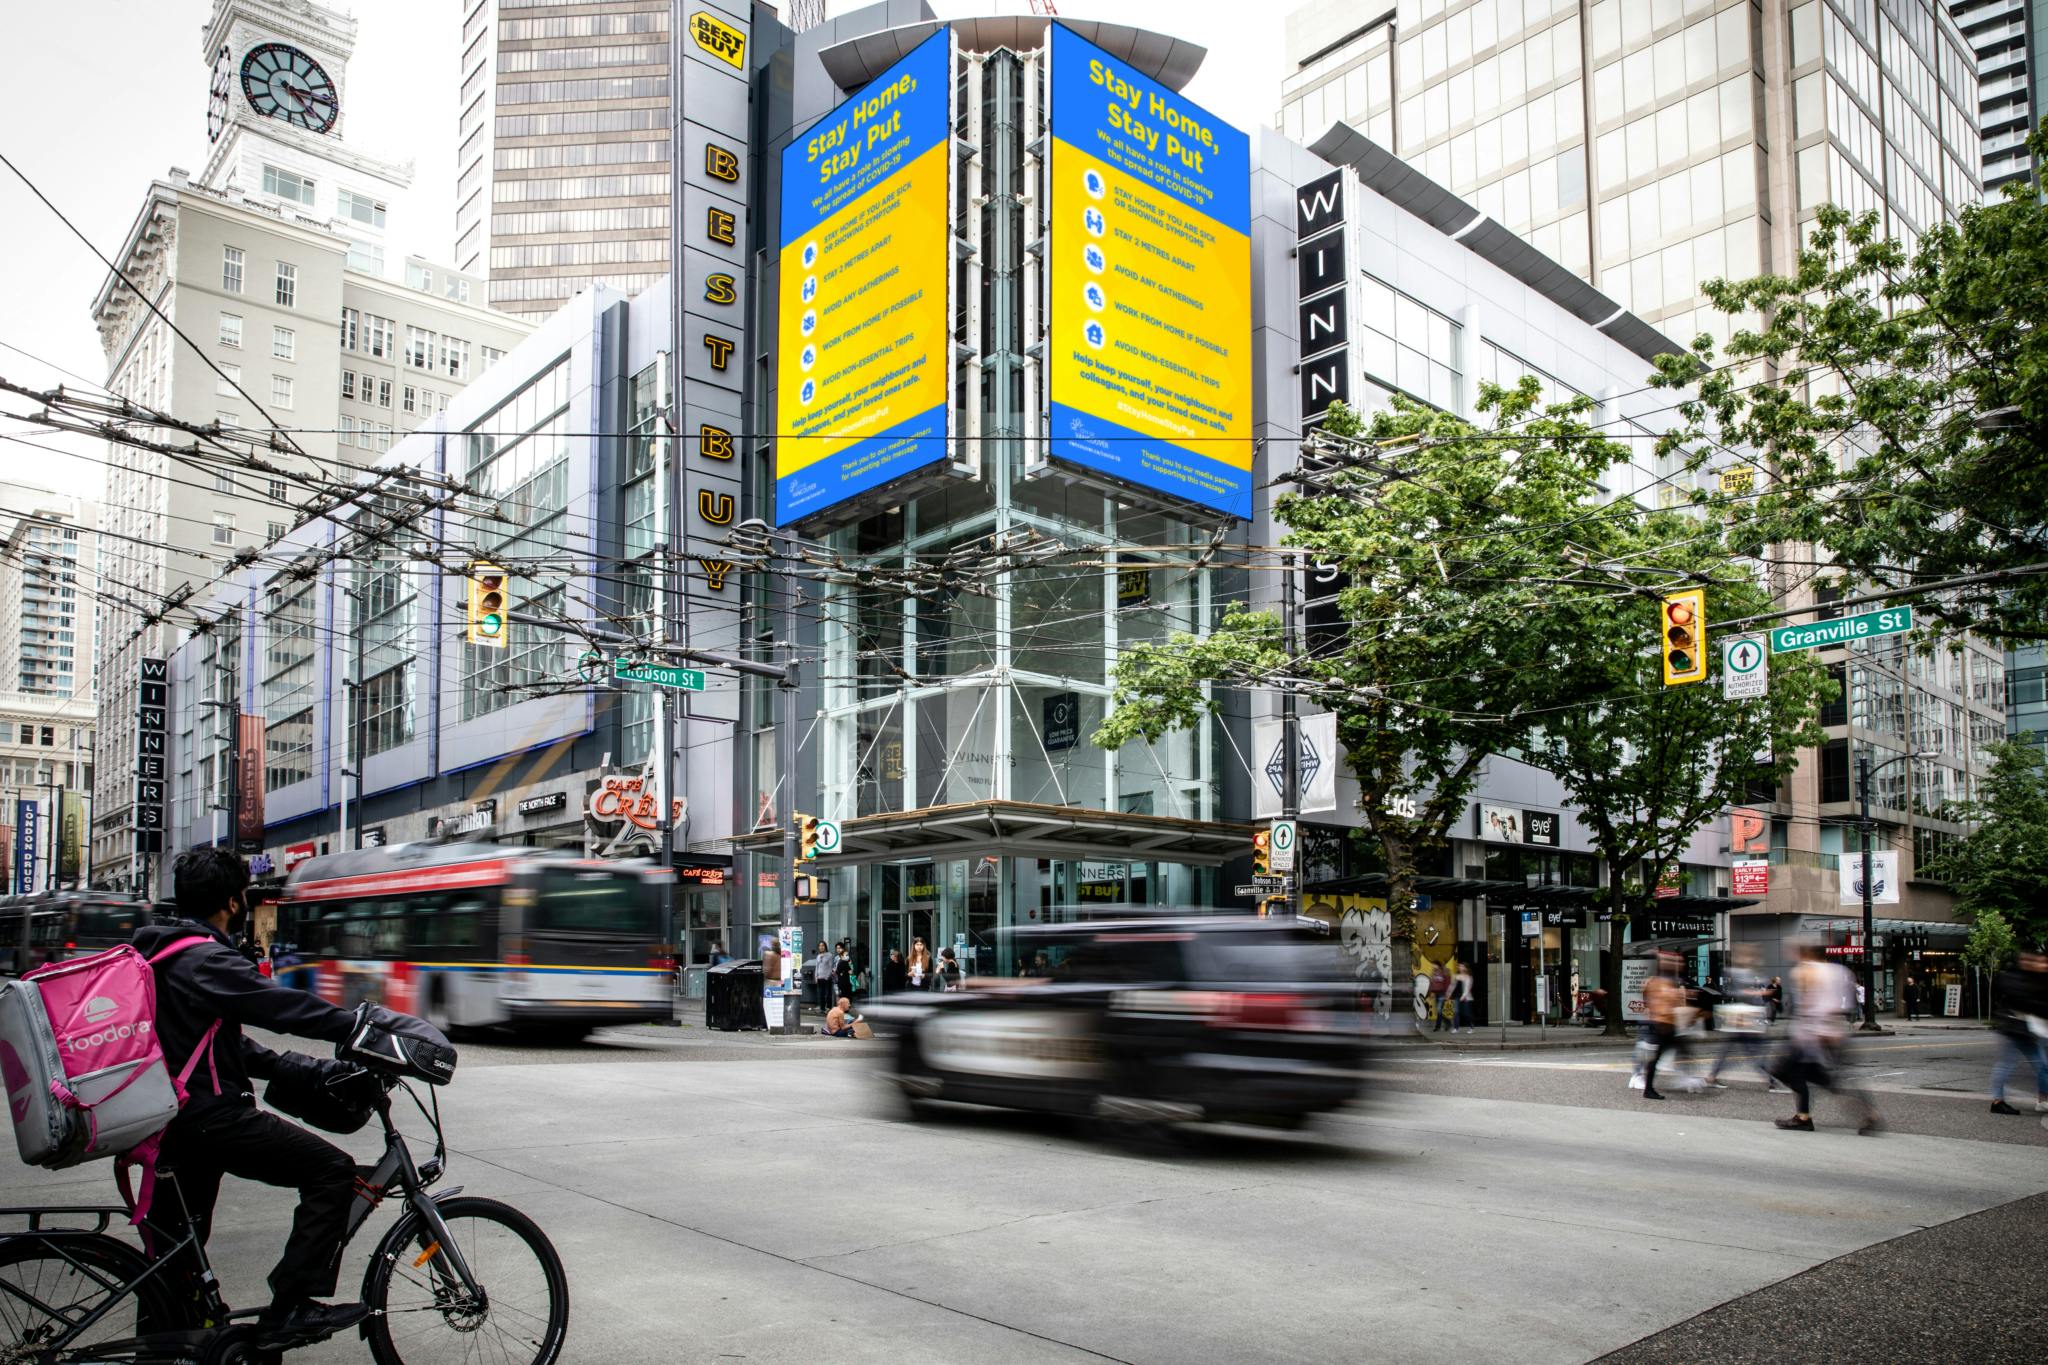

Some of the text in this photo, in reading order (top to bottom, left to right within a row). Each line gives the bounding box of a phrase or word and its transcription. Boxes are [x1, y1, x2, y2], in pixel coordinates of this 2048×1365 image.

[697, 17, 743, 50] BEST
[698, 30, 738, 59] BUY
[807, 74, 917, 163] Stay Home,
[1089, 59, 1219, 155] Stay Home,
[820, 109, 901, 184] Stay Put
[1107, 102, 1204, 174] Stay Put
[811, 135, 911, 208] We all have a role in slowing
[819, 153, 901, 215] the spread of COVID-19
[1096, 128, 1214, 200] We all have a role in slowing
[1107, 147, 1204, 206] the spread of COVID-19
[823, 181, 913, 244] STAY HOME IF YOU ARE SICK
[823, 199, 901, 254] OR SHOWING SYMPTOMS
[1114, 186, 1216, 243] STAY HOME IF YOU ARE SICK
[1114, 197, 1205, 249] OR SHOWING SYMPTOMS
[823, 234, 892, 283] STAY 2 METRES APART
[1114, 227, 1196, 272] STAY 2 METRES APART
[823, 265, 900, 316] AVOID ANY GATHERINGS
[1114, 264, 1204, 311] AVOID ANY GATHERINGS
[822, 289, 924, 351] WORK FROM HOME IF POSSIBLE
[1114, 302, 1228, 357] WORK FROM HOME IF POSSIBLE
[699, 143, 740, 591] BEST BUY
[822, 332, 914, 387] AVOID NON-ESSENTIAL TRIPS
[1114, 339, 1221, 389] AVOID NON-ESSENTIAL TRIPS
[1299, 181, 1341, 583] WINNS
[1073, 351, 1233, 422] Help keep yourself, your neighbours and
[1079, 370, 1227, 433] colleagues, and your loved ones safe.
[1724, 471, 1753, 482] BEST
[1780, 612, 1903, 648] Granville St
[682, 672, 695, 687] St
[1728, 680, 1763, 689] AUTHORIZED
[1730, 687, 1761, 696] VEHICLES
[1732, 673, 1757, 682] EXCEPT
[143, 662, 166, 823] WINNERS
[519, 795, 557, 811] THE NORTH FACE
[605, 776, 643, 792] CAFÉ
[24, 804, 34, 891] LONDON DRUGS
[1732, 809, 1765, 853] P
[683, 868, 700, 876] CAFÉ
[908, 884, 933, 897] BEST
[1095, 884, 1121, 897] BUY
[1651, 921, 1677, 932] CITY
[1677, 922, 1706, 931] CANNABIS
[65, 1020, 150, 1053] foodora
